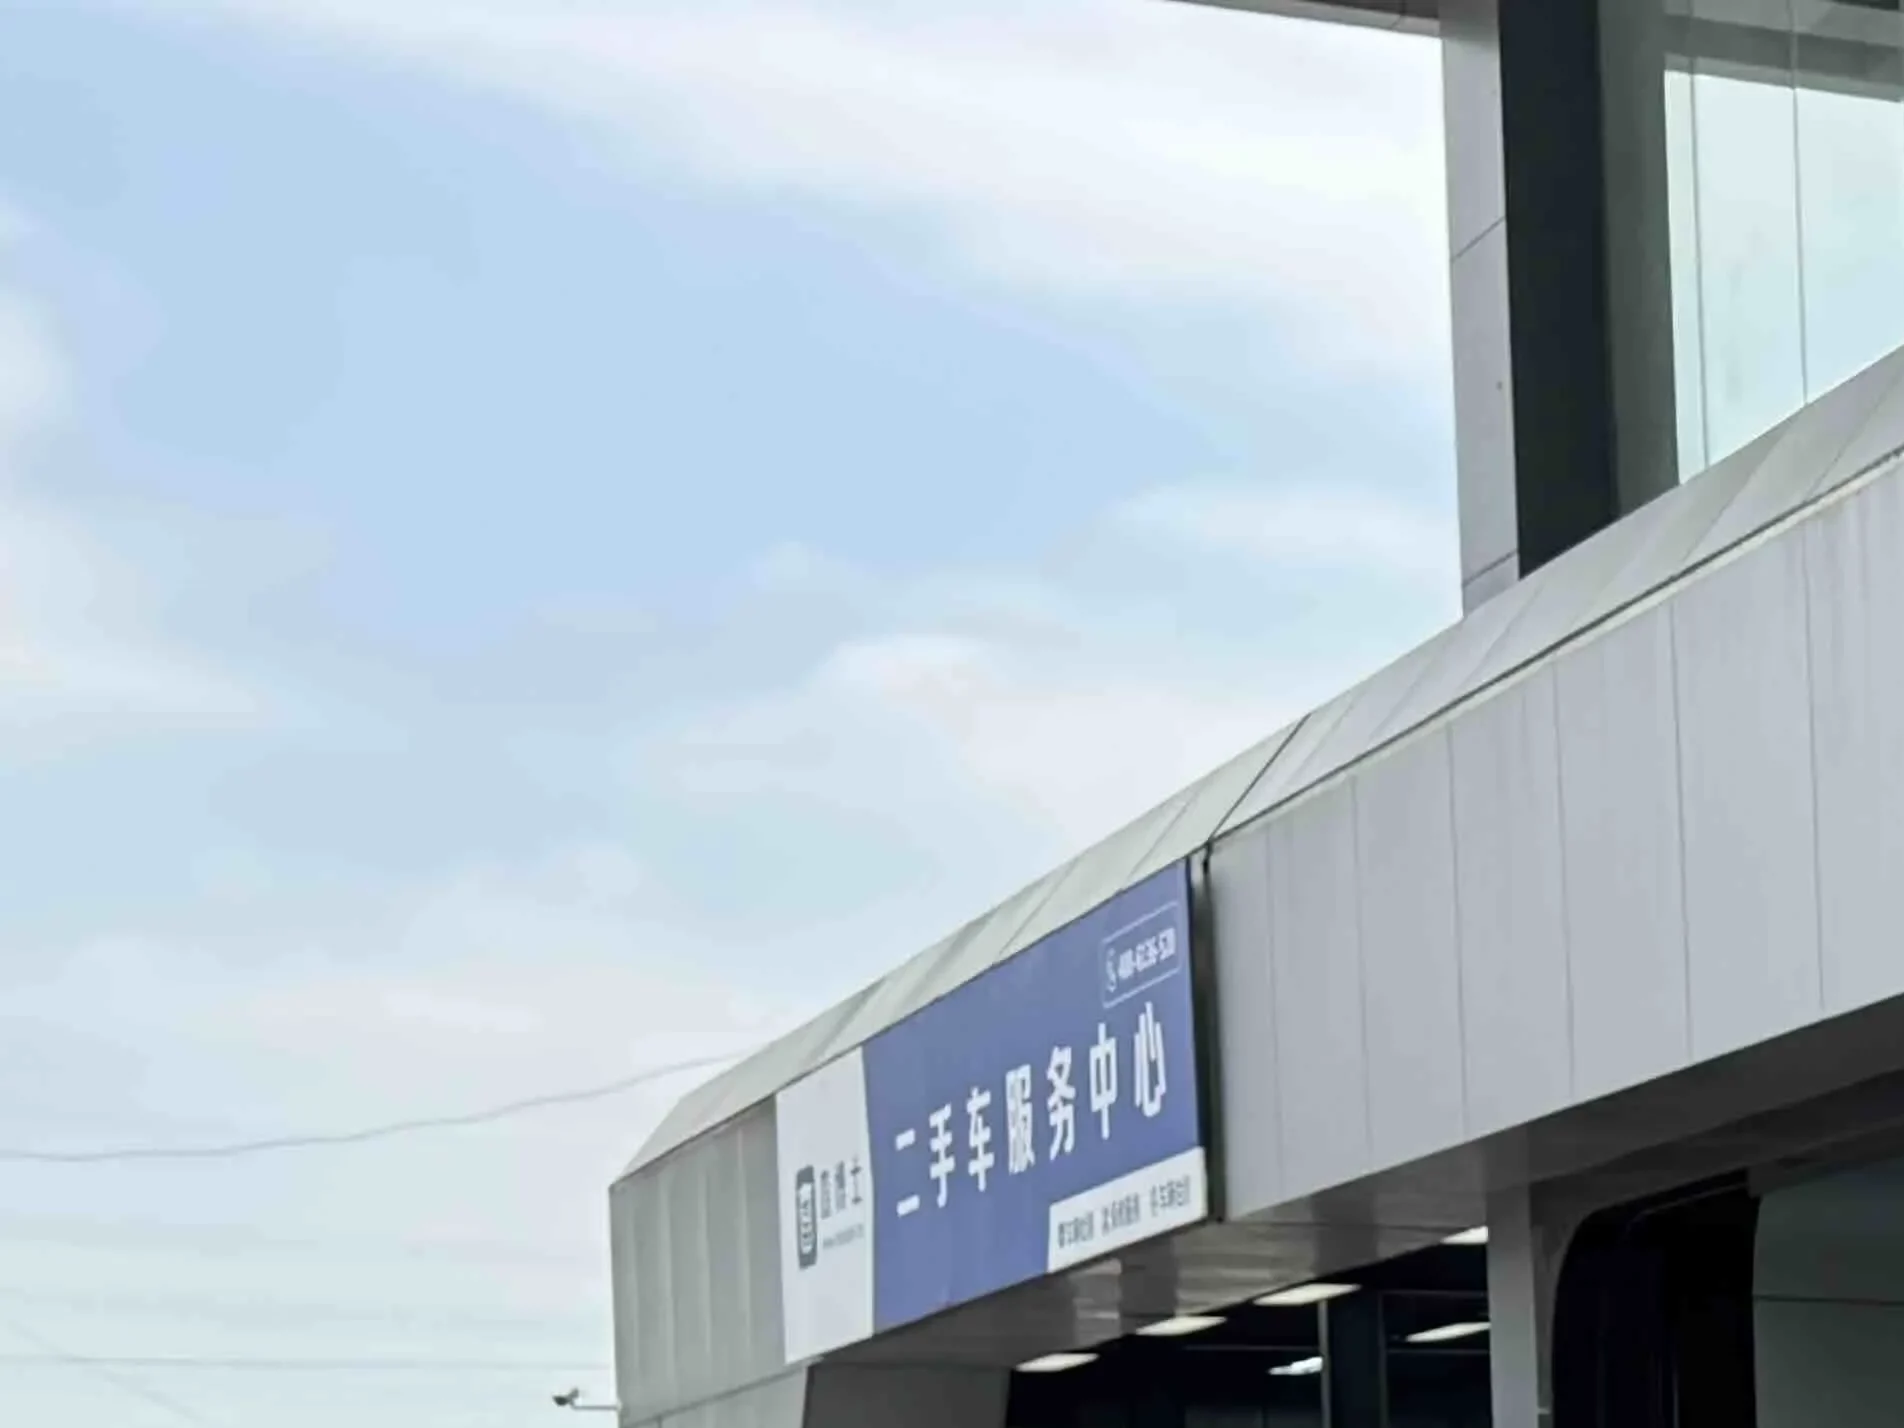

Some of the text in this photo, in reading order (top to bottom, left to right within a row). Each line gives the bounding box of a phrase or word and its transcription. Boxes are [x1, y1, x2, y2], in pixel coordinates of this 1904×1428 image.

[895, 1000, 1167, 1217] 二手车服务中心
